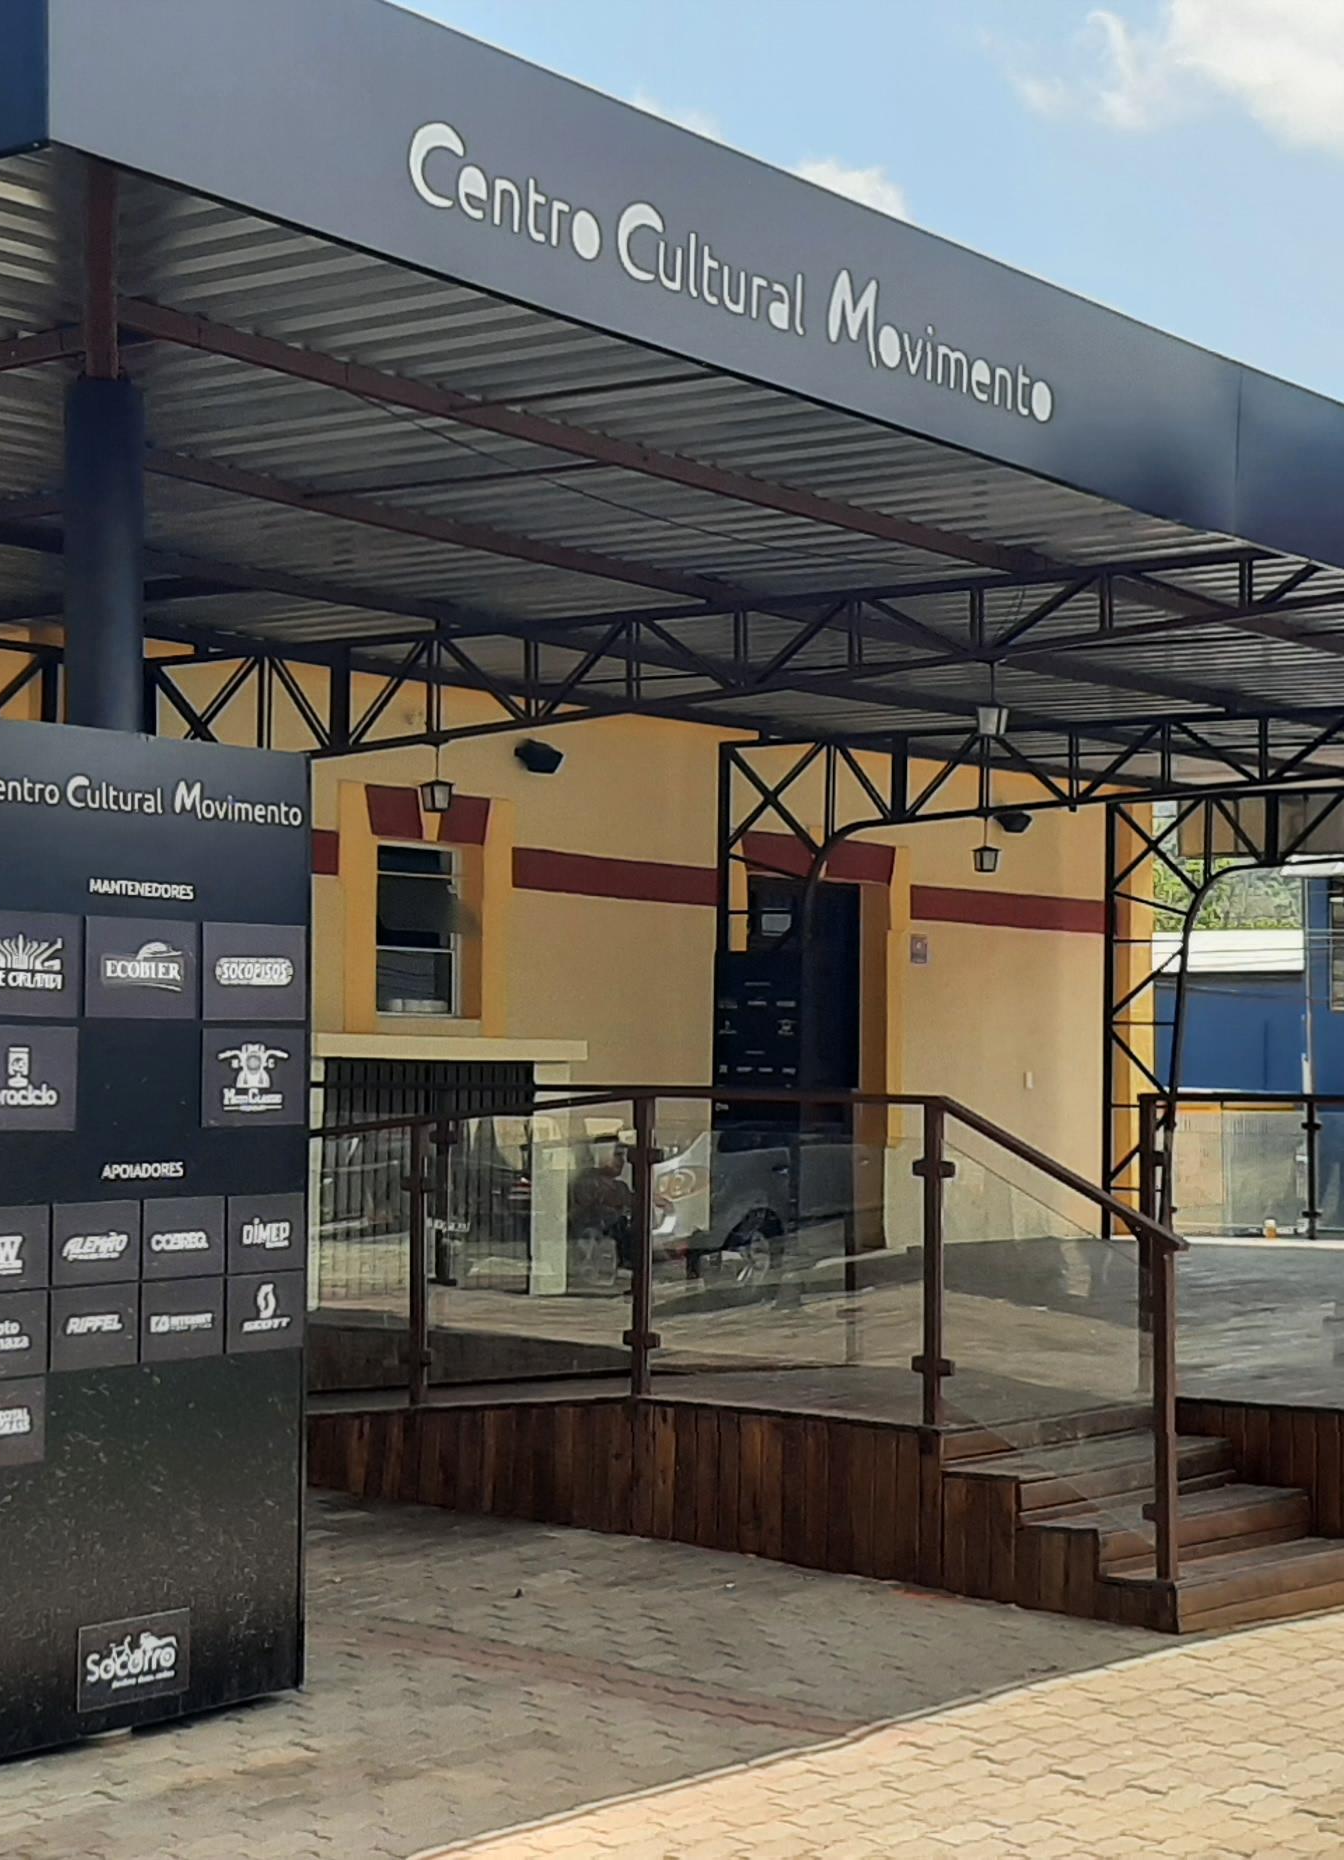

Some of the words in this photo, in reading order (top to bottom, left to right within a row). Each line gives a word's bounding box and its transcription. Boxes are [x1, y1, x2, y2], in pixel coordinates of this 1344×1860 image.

[407, 121, 602, 260] Centro
[617, 202, 807, 336] Cultural
[826, 268, 1054, 424] Movimento
[66, 775, 163, 814] Cultural
[174, 780, 303, 827] Movimento
[89, 878, 194, 900] MANTENEDORES
[106, 959, 181, 981] ECOBIER
[101, 1161, 184, 1179] APOIADORES
[242, 1317, 291, 1333] SCOTT
